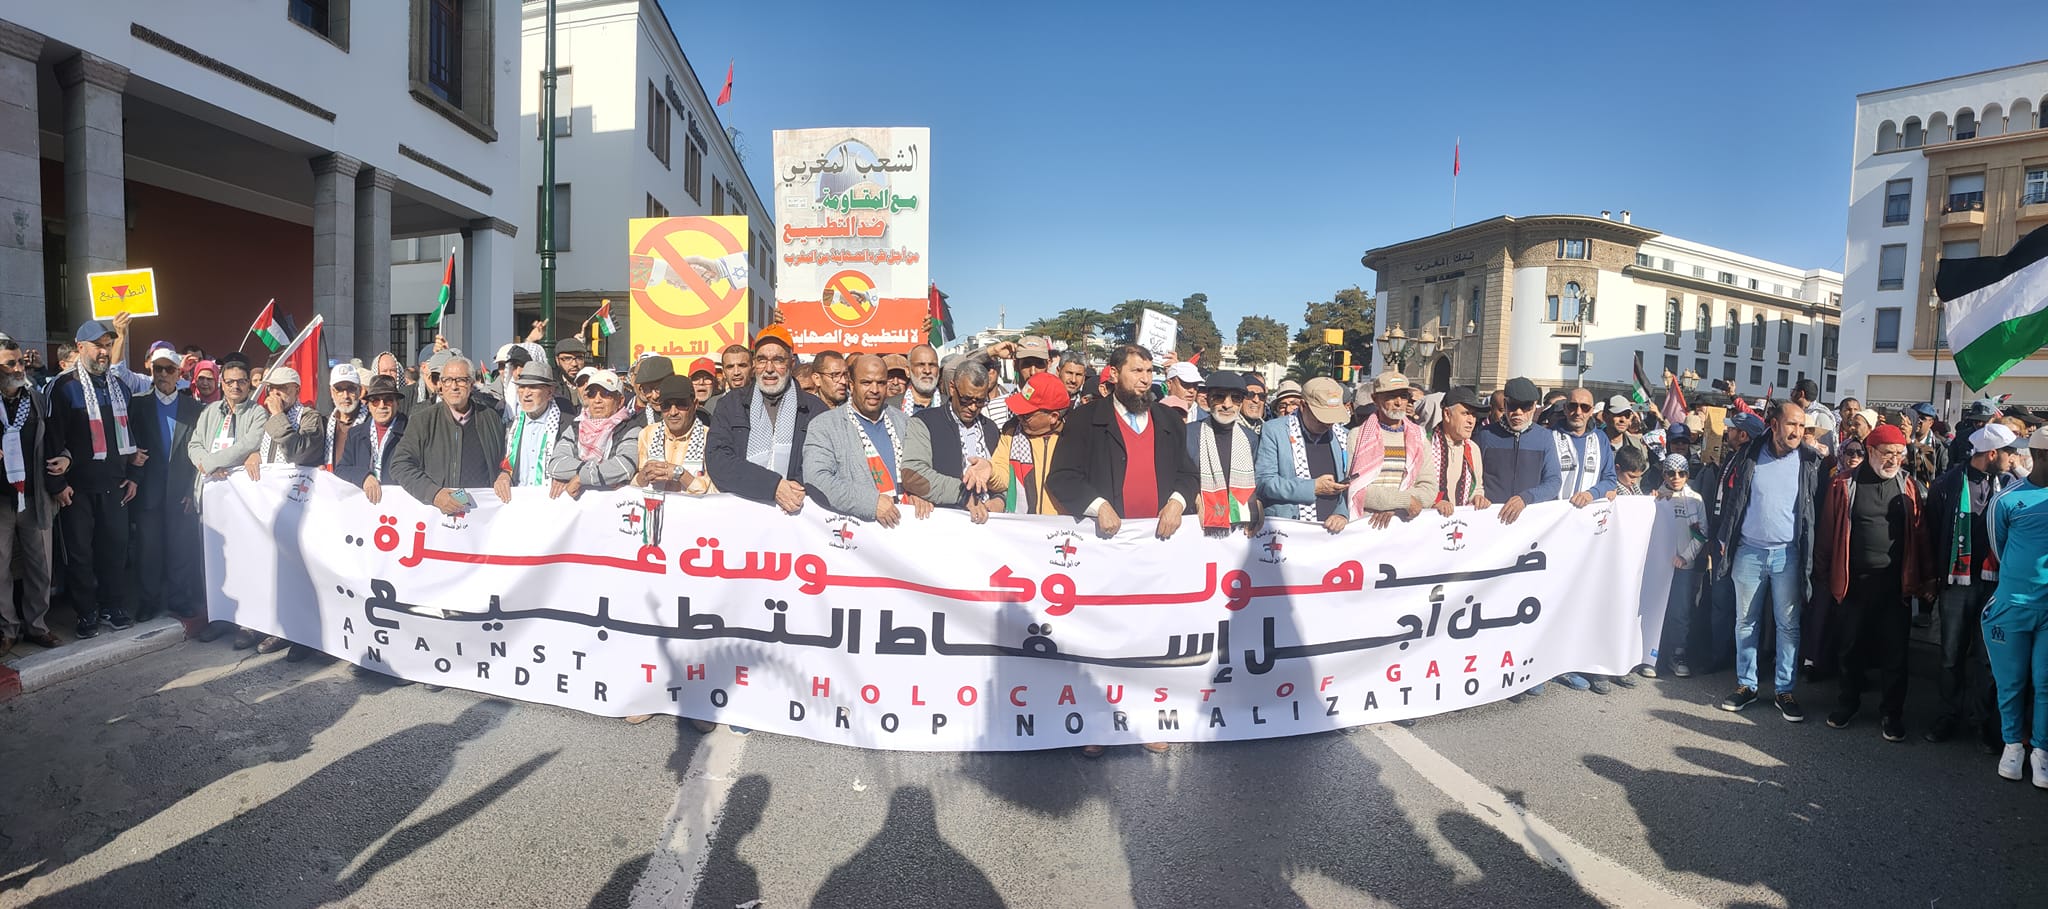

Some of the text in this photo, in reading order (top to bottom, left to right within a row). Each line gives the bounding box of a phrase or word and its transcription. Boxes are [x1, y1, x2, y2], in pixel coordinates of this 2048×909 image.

[783, 144, 918, 187] الشعب المغربي
[890, 193, 918, 213] مع
[783, 216, 886, 243] ضد التطبيع
[843, 332, 859, 347] مع
[861, 328, 909, 347] للتطبيع
[910, 328, 919, 343] لا
[679, 536, 1364, 617] هولوكوست
[1375, 541, 1547, 589] ضد
[1244, 584, 1446, 676] أجل
[1448, 595, 1542, 640] من
[343, 616, 587, 670] AGAINST
[641, 663, 749, 686] THE
[811, 676, 1217, 707] HOLOCAUST
[1276, 675, 1335, 699] OF
[874, 609, 1234, 684] إسقاط
[343, 634, 382, 663] IN
[434, 656, 608, 702] ORDER
[667, 686, 729, 708] TO
[789, 700, 948, 735] DROP
